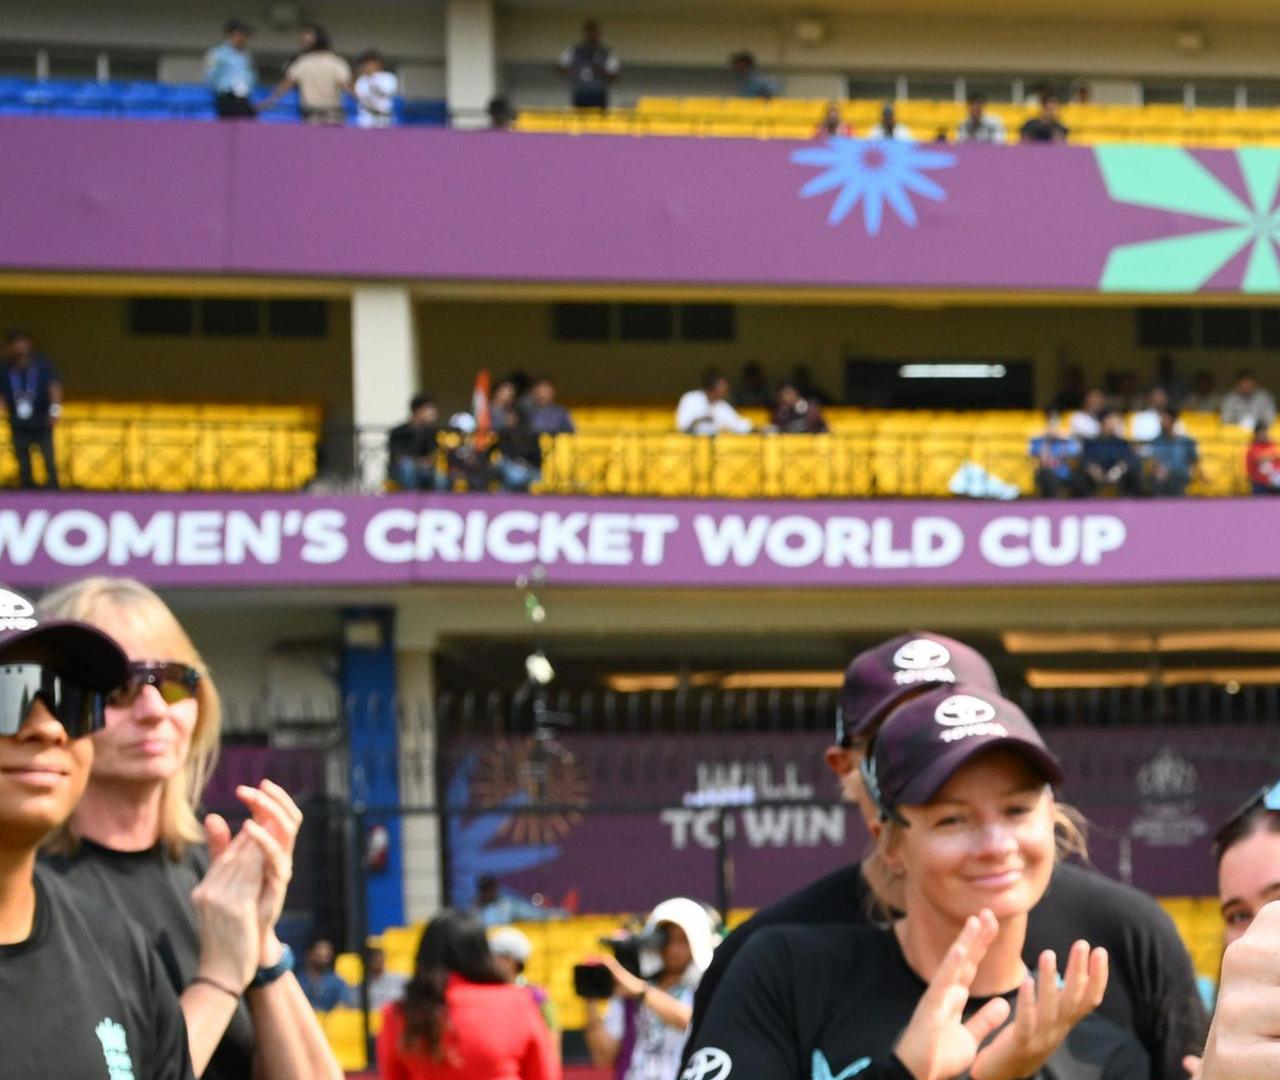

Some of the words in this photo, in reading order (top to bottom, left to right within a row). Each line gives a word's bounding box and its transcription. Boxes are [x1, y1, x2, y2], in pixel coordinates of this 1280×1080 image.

[0, 509, 348, 566] WOMEN'S
[364, 509, 679, 566] CRICKET
[694, 514, 965, 568] WORLD
[978, 514, 1127, 568] CUP
[741, 805, 848, 848] WIN
